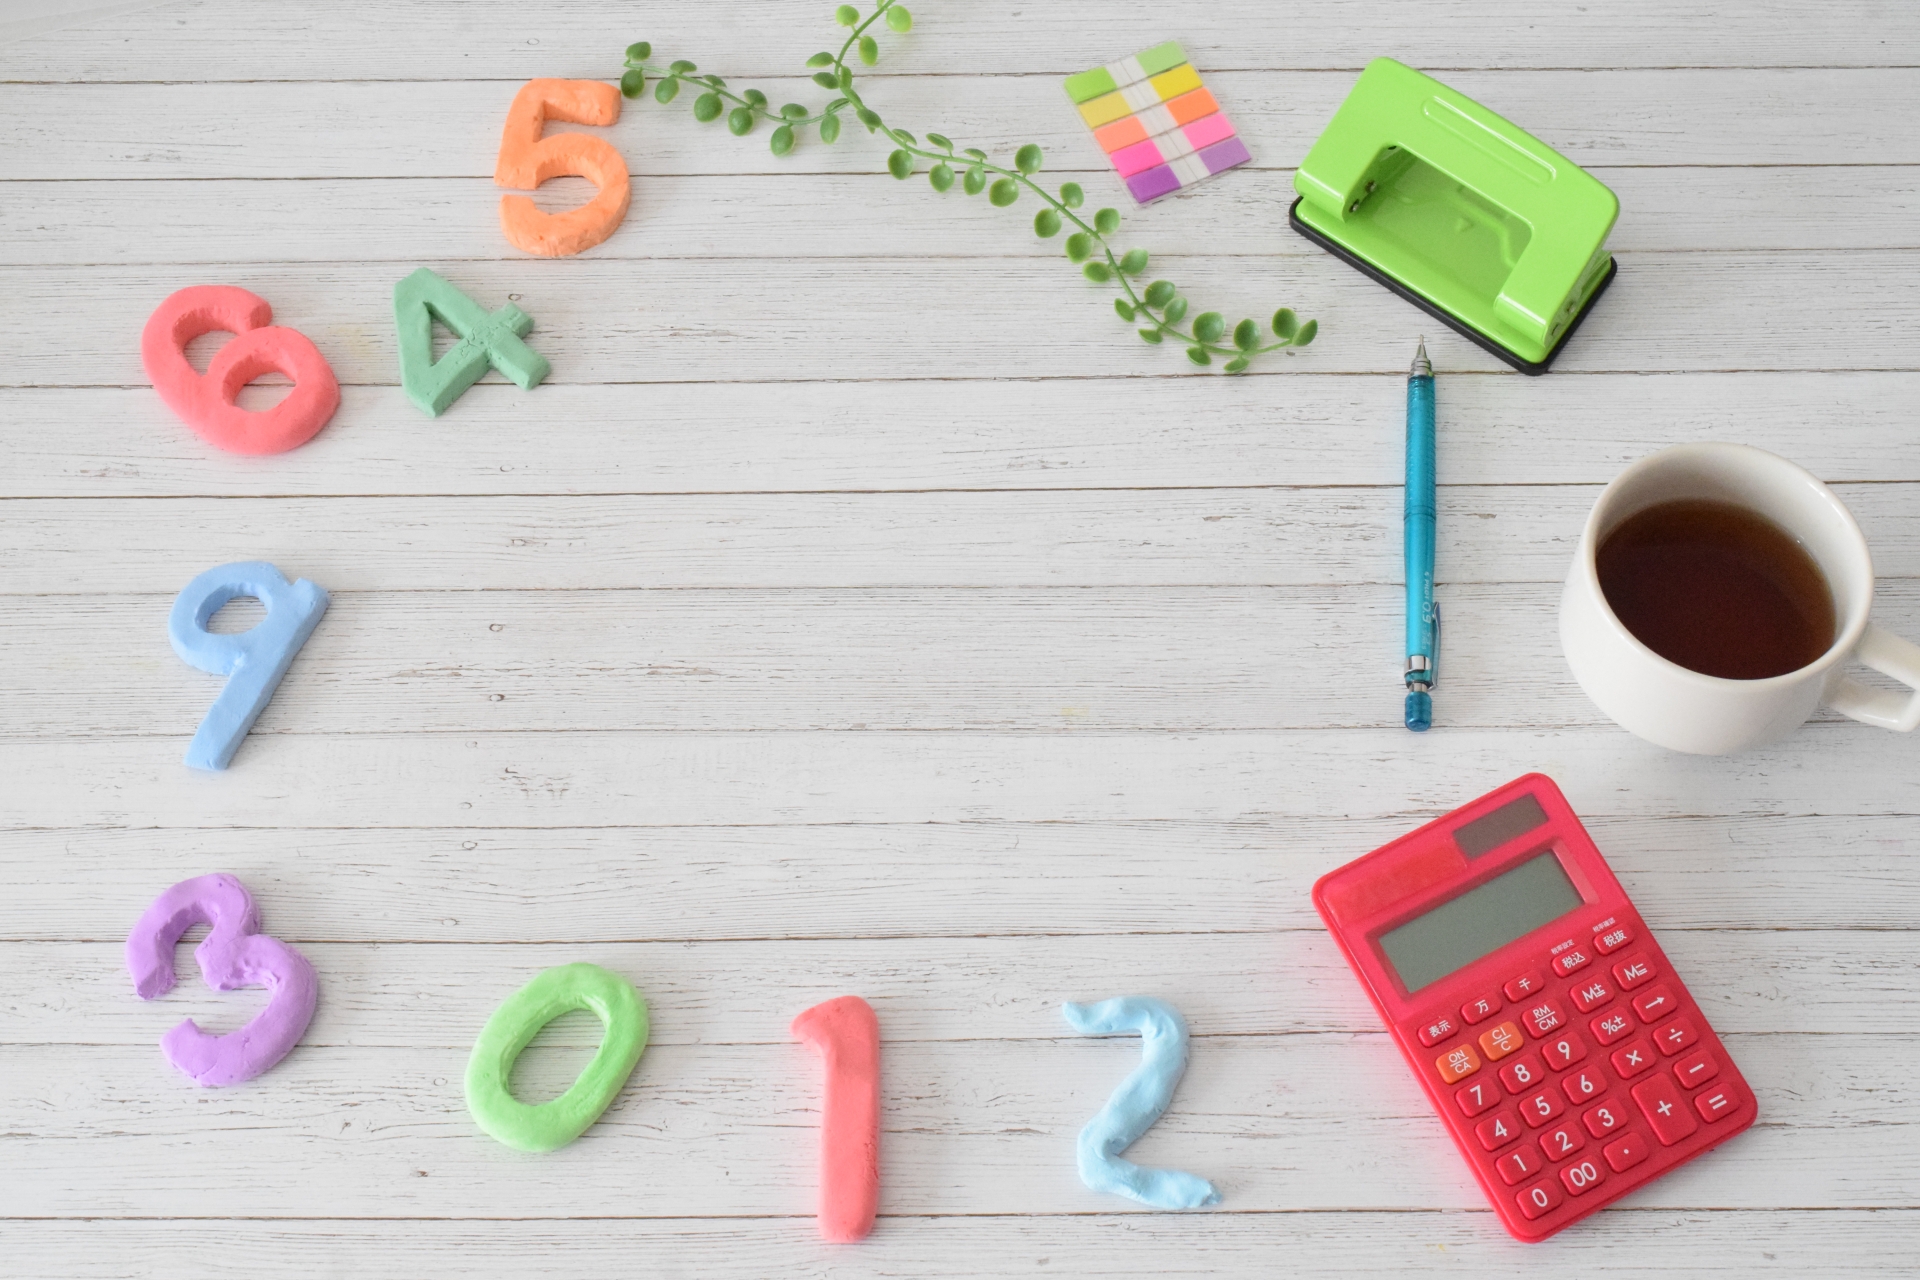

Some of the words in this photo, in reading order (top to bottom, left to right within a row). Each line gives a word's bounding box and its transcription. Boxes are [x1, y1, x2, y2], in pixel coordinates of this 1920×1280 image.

[494, 78, 631, 256] 5
[393, 267, 551, 417] 4
[141, 284, 341, 455] 6
[168, 561, 329, 770] 9
[1602, 929, 1627, 947] 税抜
[1561, 951, 1586, 969] 税込
[126, 873, 317, 1087] 3
[1518, 978, 1531, 990] 千
[1475, 999, 1489, 1014] 万
[1532, 1004, 1551, 1019] RM
[1428, 1020, 1451, 1037] 表示
[1538, 1017, 1559, 1031] CM
[465, 962, 650, 1151] 0
[1448, 1050, 1466, 1063] ON
[1557, 1041, 1570, 1060] 9
[1454, 1062, 1472, 1074] CA
[1514, 1064, 1531, 1082] 8
[1580, 1074, 1594, 1093] 6
[1062, 996, 1222, 1208] 2
[1469, 1085, 1482, 1106] 7
[1535, 1096, 1551, 1116] 5
[789, 995, 881, 1244] 1
[1598, 1108, 1614, 1127] 3
[1495, 1119, 1508, 1137] 4
[1555, 1131, 1573, 1151] 2
[1513, 1154, 1527, 1172] 1
[1569, 1162, 1597, 1187] 00
[1531, 1188, 1548, 1207] 0
